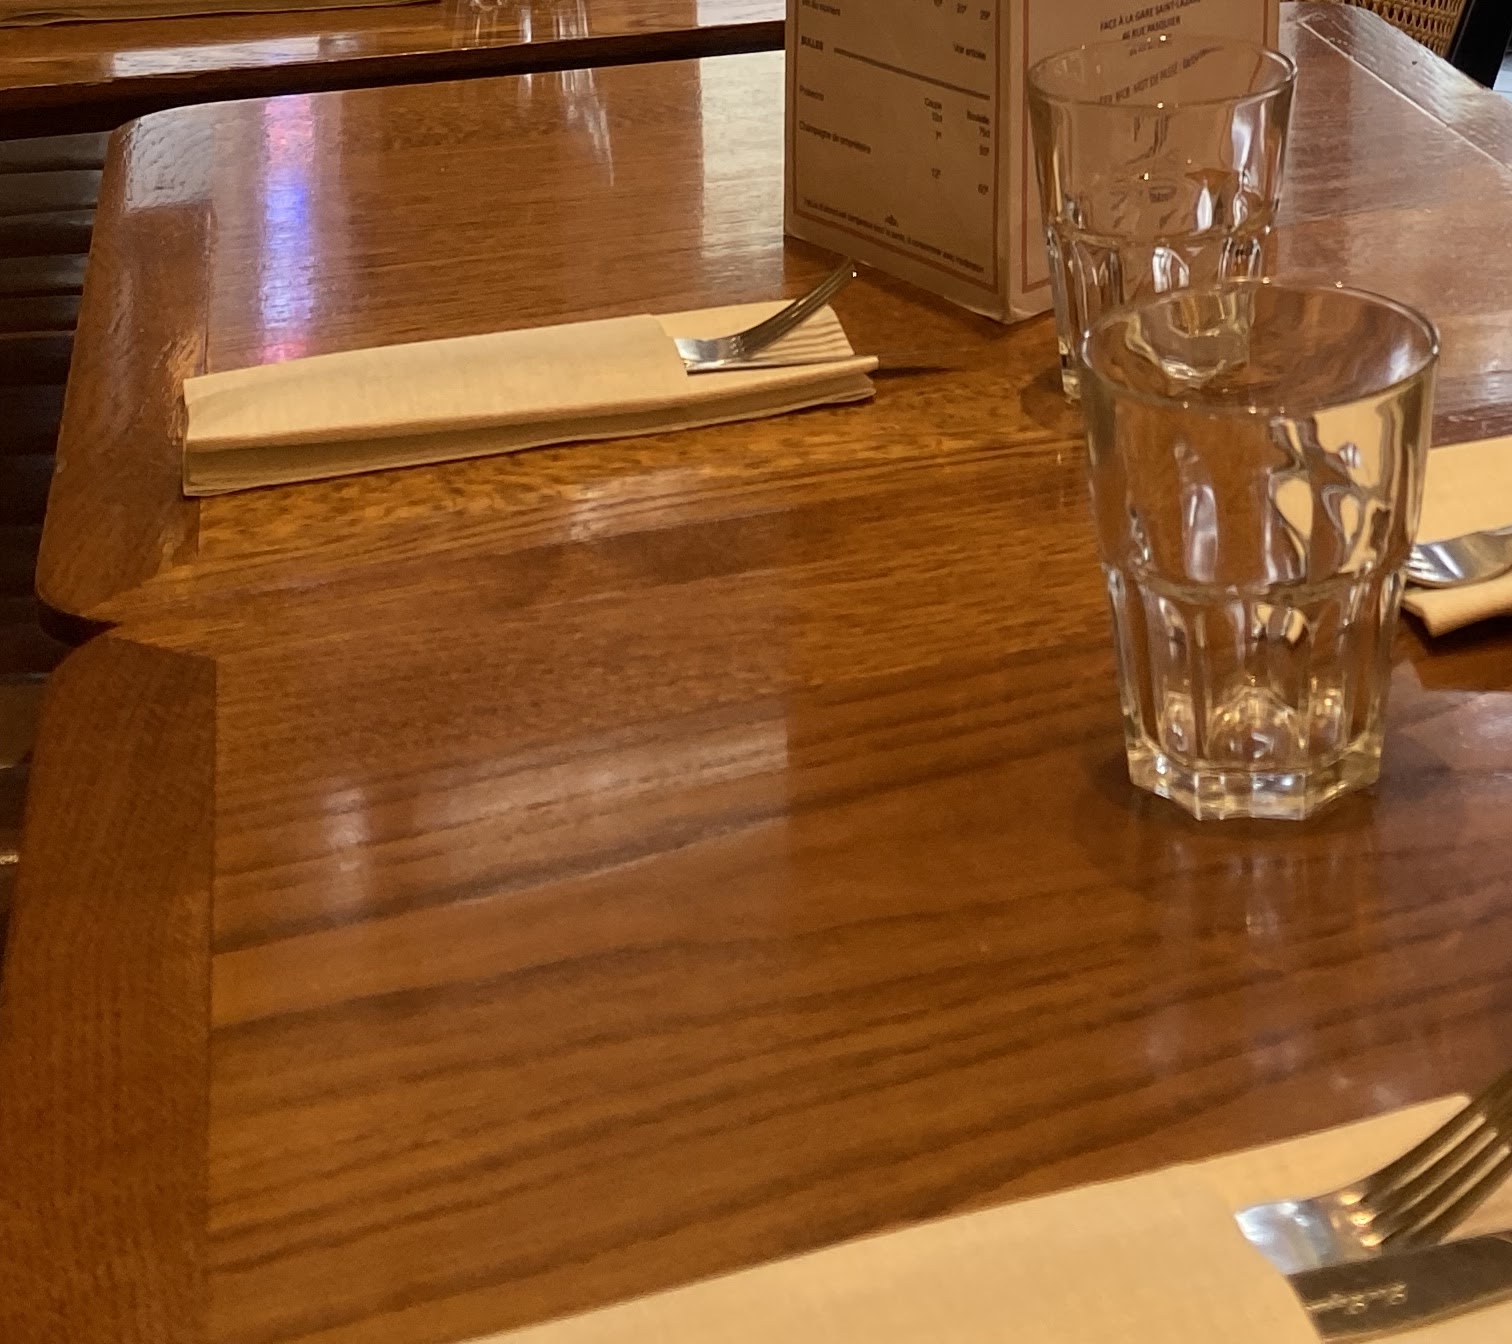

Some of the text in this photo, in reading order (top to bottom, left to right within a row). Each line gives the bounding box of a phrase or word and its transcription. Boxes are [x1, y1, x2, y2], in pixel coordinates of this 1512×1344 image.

[1100, 18, 1117, 32] FACE
[1125, 13, 1134, 25] LA
[1135, 7, 1154, 22] GARE
